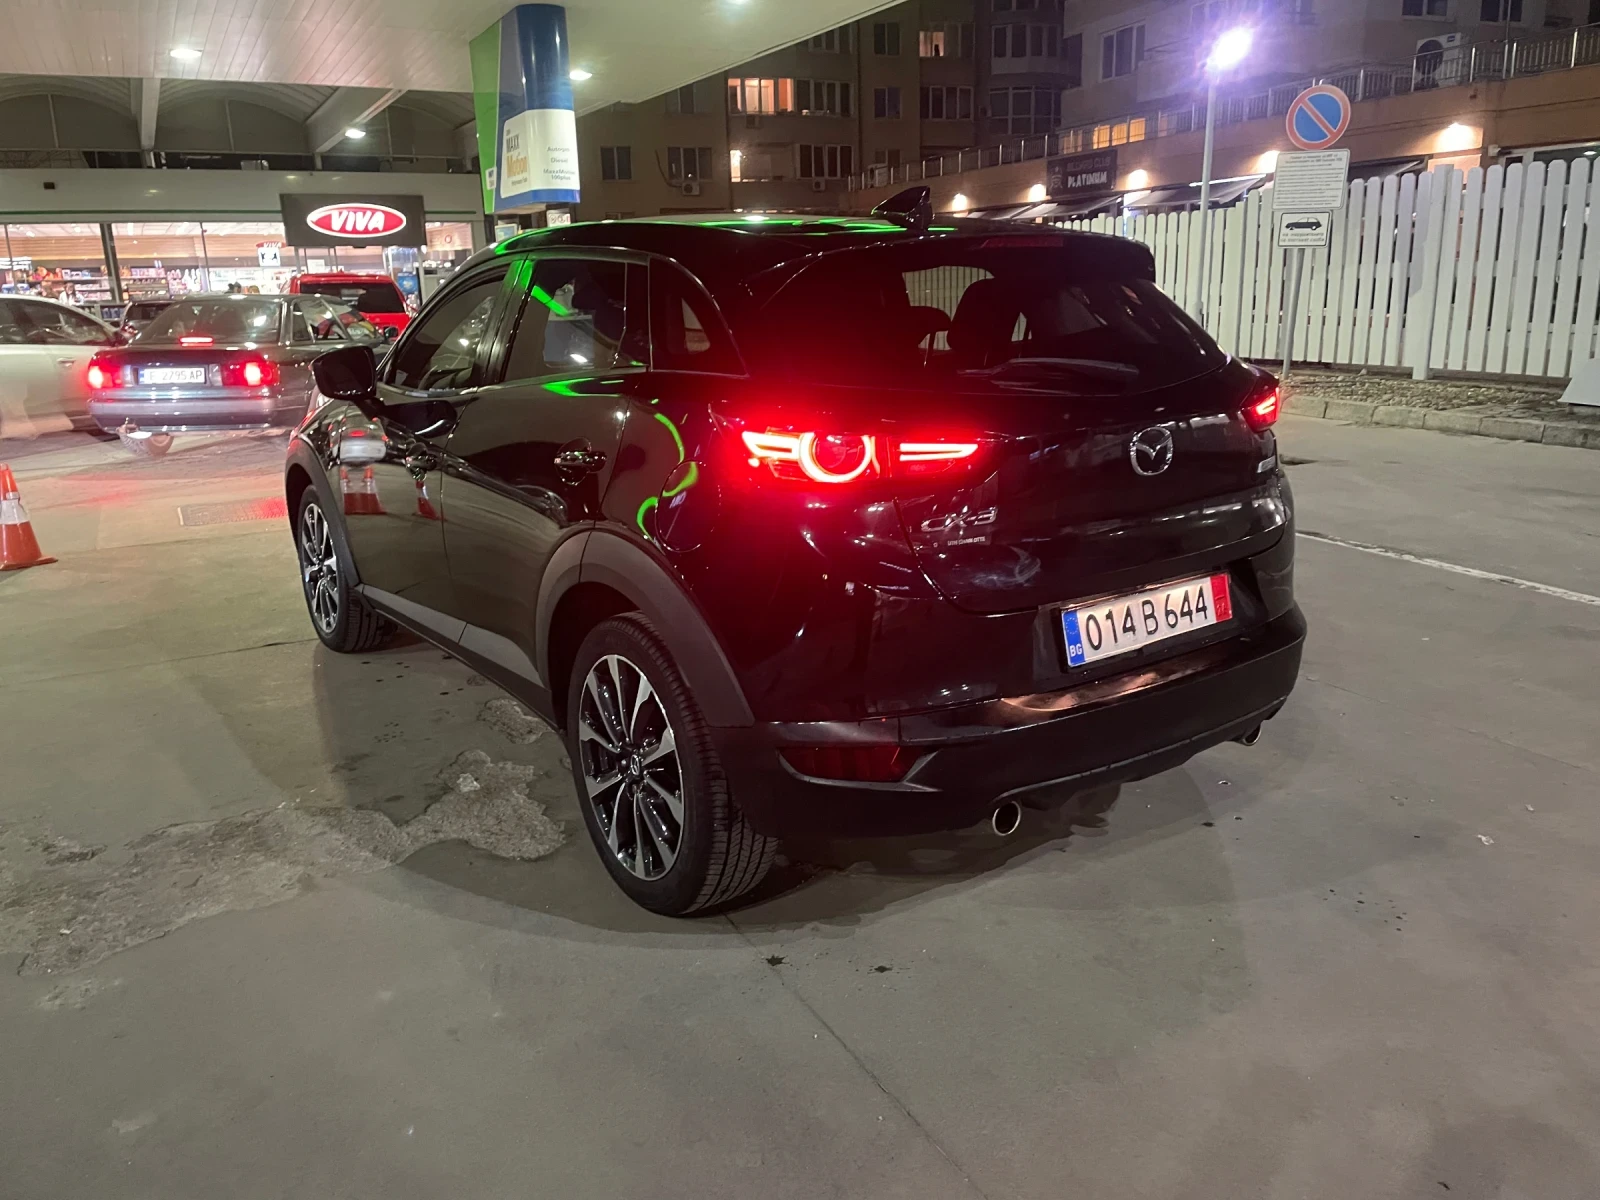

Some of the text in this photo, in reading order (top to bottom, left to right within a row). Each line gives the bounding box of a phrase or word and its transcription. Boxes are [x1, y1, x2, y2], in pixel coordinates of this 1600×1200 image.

[506, 134, 520, 153] MAXX
[1067, 171, 1108, 188] PLATINUM
[330, 209, 385, 232] VIVA
[921, 505, 998, 532] CX-3
[1069, 643, 1083, 657] BG
